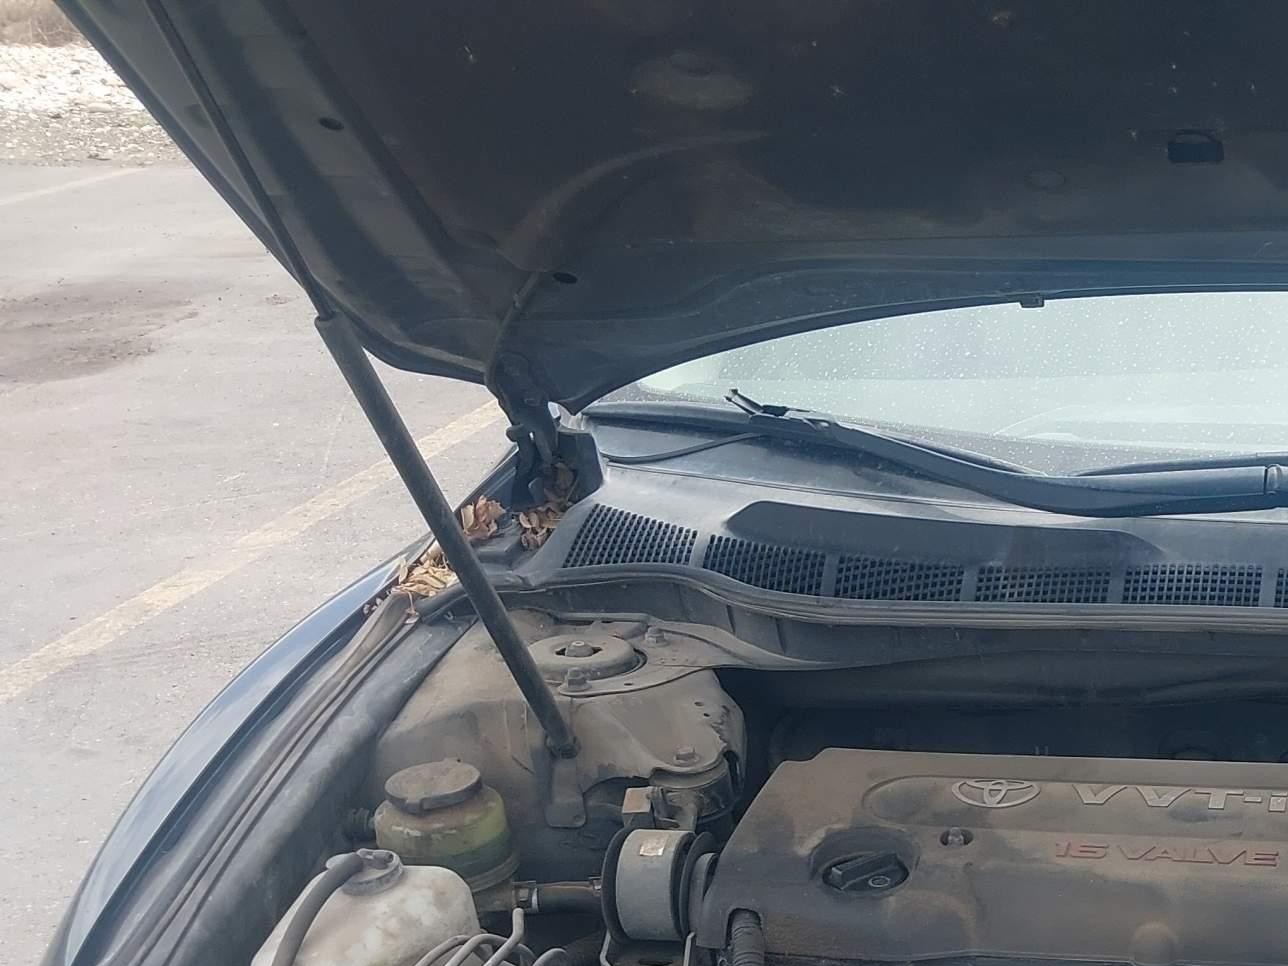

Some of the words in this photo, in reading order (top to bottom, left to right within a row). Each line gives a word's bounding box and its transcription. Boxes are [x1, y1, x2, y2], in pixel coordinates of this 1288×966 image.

[1071, 784, 1288, 813] VVT-i
[1054, 841, 1110, 860] 16
[1117, 845, 1280, 867] VALVE
